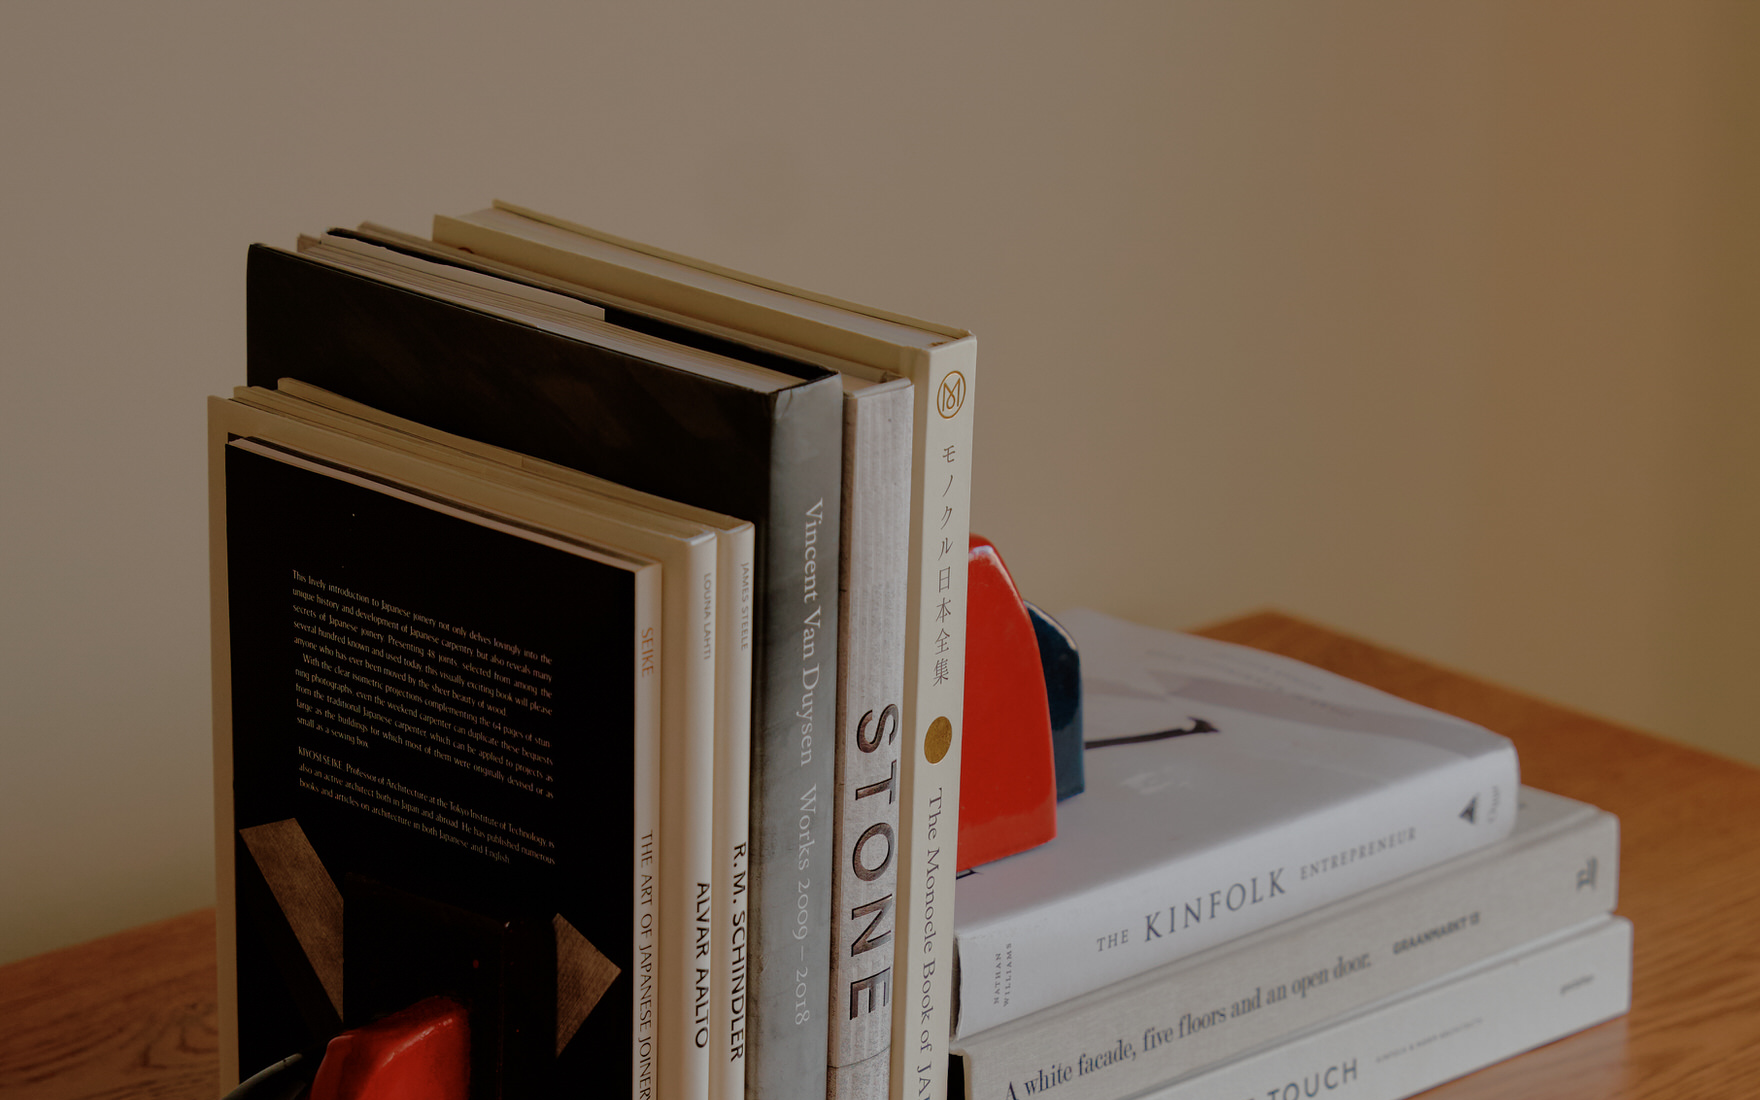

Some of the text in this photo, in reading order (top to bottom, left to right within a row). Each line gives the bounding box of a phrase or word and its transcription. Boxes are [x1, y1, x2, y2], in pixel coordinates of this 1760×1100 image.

[803, 497, 824, 604] Vincent
[931, 443, 958, 688] モノクル日本全集
[292, 569, 307, 583] This
[308, 575, 327, 591] lively
[328, 584, 370, 604] introduction
[380, 599, 411, 618] Japanese
[412, 612, 437, 628] joinery
[451, 626, 467, 638] only
[468, 629, 492, 645] delves
[493, 637, 521, 656] lovingly
[523, 650, 539, 660] into
[292, 588, 316, 602] unique
[316, 593, 340, 612] history
[341, 604, 355, 616] and
[355, 607, 399, 631] development
[409, 625, 440, 645] Japanese
[490, 654, 505, 666] also
[506, 660, 531, 674] reveals
[532, 669, 553, 683] many
[292, 604, 317, 619] secrets
[328, 614, 359, 633] Japanese
[387, 634, 425, 658] Presenting
[461, 662, 492, 678] selected
[493, 671, 511, 685] from
[513, 680, 538, 696] among
[703, 572, 713, 660] LOUNA LAHTI
[740, 562, 750, 652] JAMES STEELE
[802, 605, 822, 661] Van
[293, 620, 317, 635] several
[317, 627, 346, 645] hundred
[347, 636, 370, 653] known
[371, 647, 385, 658] and
[385, 652, 402, 665] used
[424, 664, 439, 676] this
[439, 671, 465, 688] visually
[466, 681, 495, 698] exciting
[495, 688, 513, 702] book
[514, 697, 528, 707] will
[529, 700, 553, 716] please
[293, 638, 318, 651] anyone
[318, 645, 334, 657] who
[348, 656, 363, 667] ever
[364, 659, 382, 673] been
[383, 667, 407, 682] moved
[431, 683, 451, 697] sheer
[451, 689, 476, 707] beauty
[302, 653, 320, 668] With
[333, 665, 351, 678] clear
[352, 673, 383, 690] isometric
[384, 684, 423, 704] projections
[424, 698, 478, 725] complementing
[502, 725, 524, 739] pages
[641, 626, 655, 678] SEIKE
[294, 668, 310, 682] ning
[355, 691, 373, 702] even
[386, 701, 418, 718] weekend
[418, 712, 452, 730] carpenter
[467, 728, 499, 747] duplicate
[500, 739, 520, 754] these
[521, 746, 554, 766] bequests
[295, 683, 312, 696] from
[326, 695, 361, 714] traditional
[362, 706, 393, 725] Japanese
[429, 732, 451, 746] which
[478, 750, 504, 765] applied
[515, 763, 544, 779] projects
[296, 717, 315, 729] small
[330, 729, 356, 745] sewing
[796, 663, 820, 767] Duysen
[640, 830, 653, 868] THE
[798, 783, 817, 871] Works
[927, 787, 943, 841] The
[640, 874, 653, 905] ART
[849, 703, 900, 1021] STONE
[922, 847, 941, 954] Monocle
[1096, 826, 1417, 953] THE KINFOLK ENTREPRENEUR
[640, 913, 653, 938] OF
[730, 841, 747, 1063] R. M. SCHINDLER
[792, 878, 811, 940] 2009
[639, 943, 652, 1033] JAPANESE
[694, 882, 711, 1049] ALVAR AALTO
[794, 966, 811, 1026] 2018
[920, 959, 936, 1024] Book
[993, 952, 1002, 1006] NATHAN
[1003, 942, 1013, 1008] WILLIAMS
[919, 1029, 933, 1054] of
[1023, 1062, 1073, 1097] white
[1077, 1039, 1137, 1078] facade,
[1141, 1025, 1174, 1053] five
[1178, 1005, 1228, 1040] floors
[1230, 987, 1262, 1019] and
[1265, 984, 1288, 1006] an
[1291, 962, 1329, 999] open
[1333, 951, 1373, 980] door.
